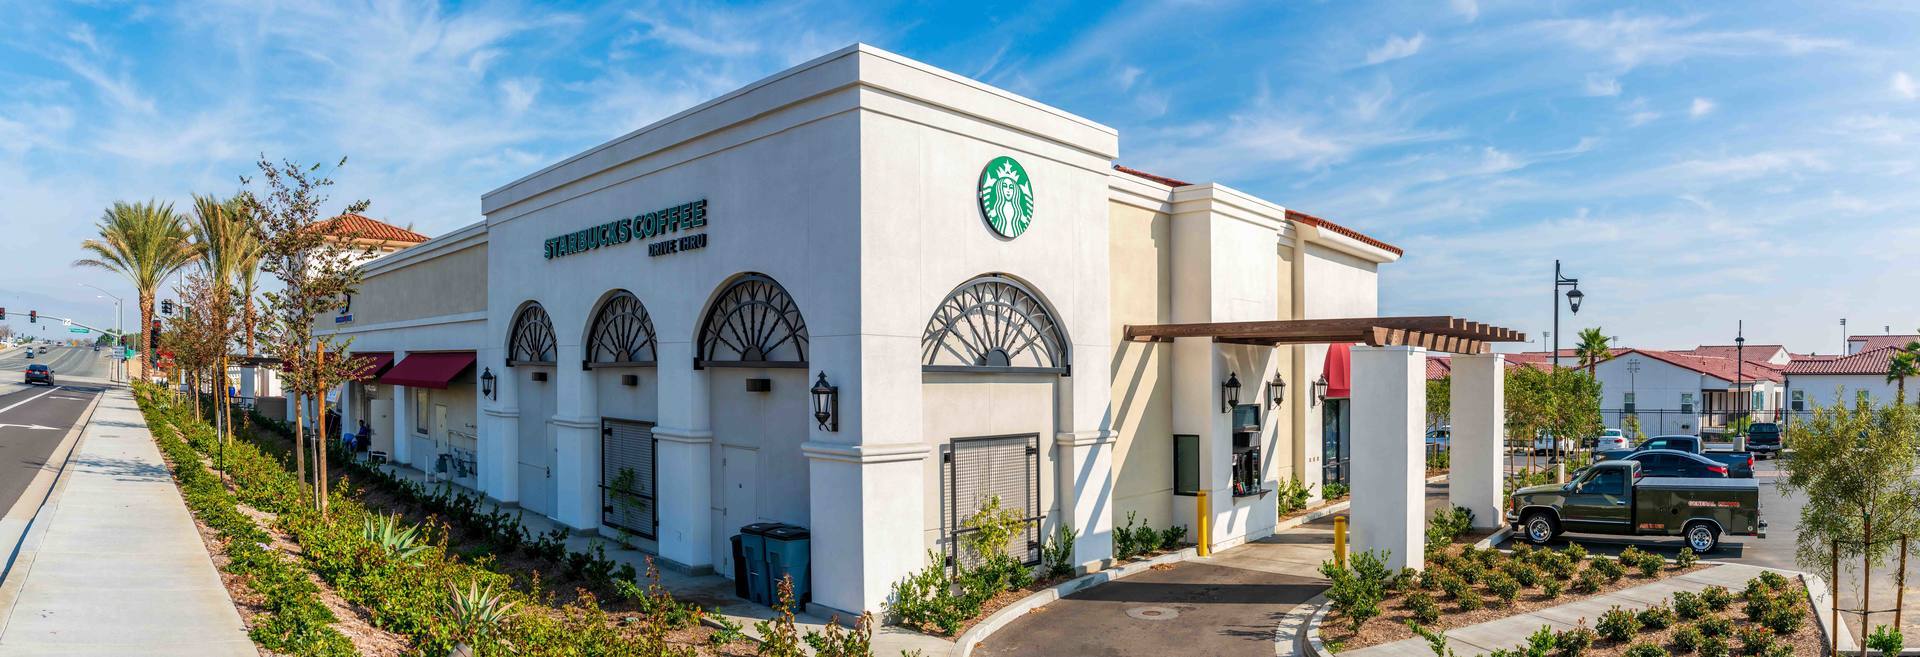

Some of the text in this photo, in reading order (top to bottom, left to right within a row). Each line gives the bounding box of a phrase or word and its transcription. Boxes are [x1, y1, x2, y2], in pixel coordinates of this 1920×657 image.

[544, 199, 707, 259] STARBUCKS COFFEE
[648, 233, 707, 257] DRIVE THRU
